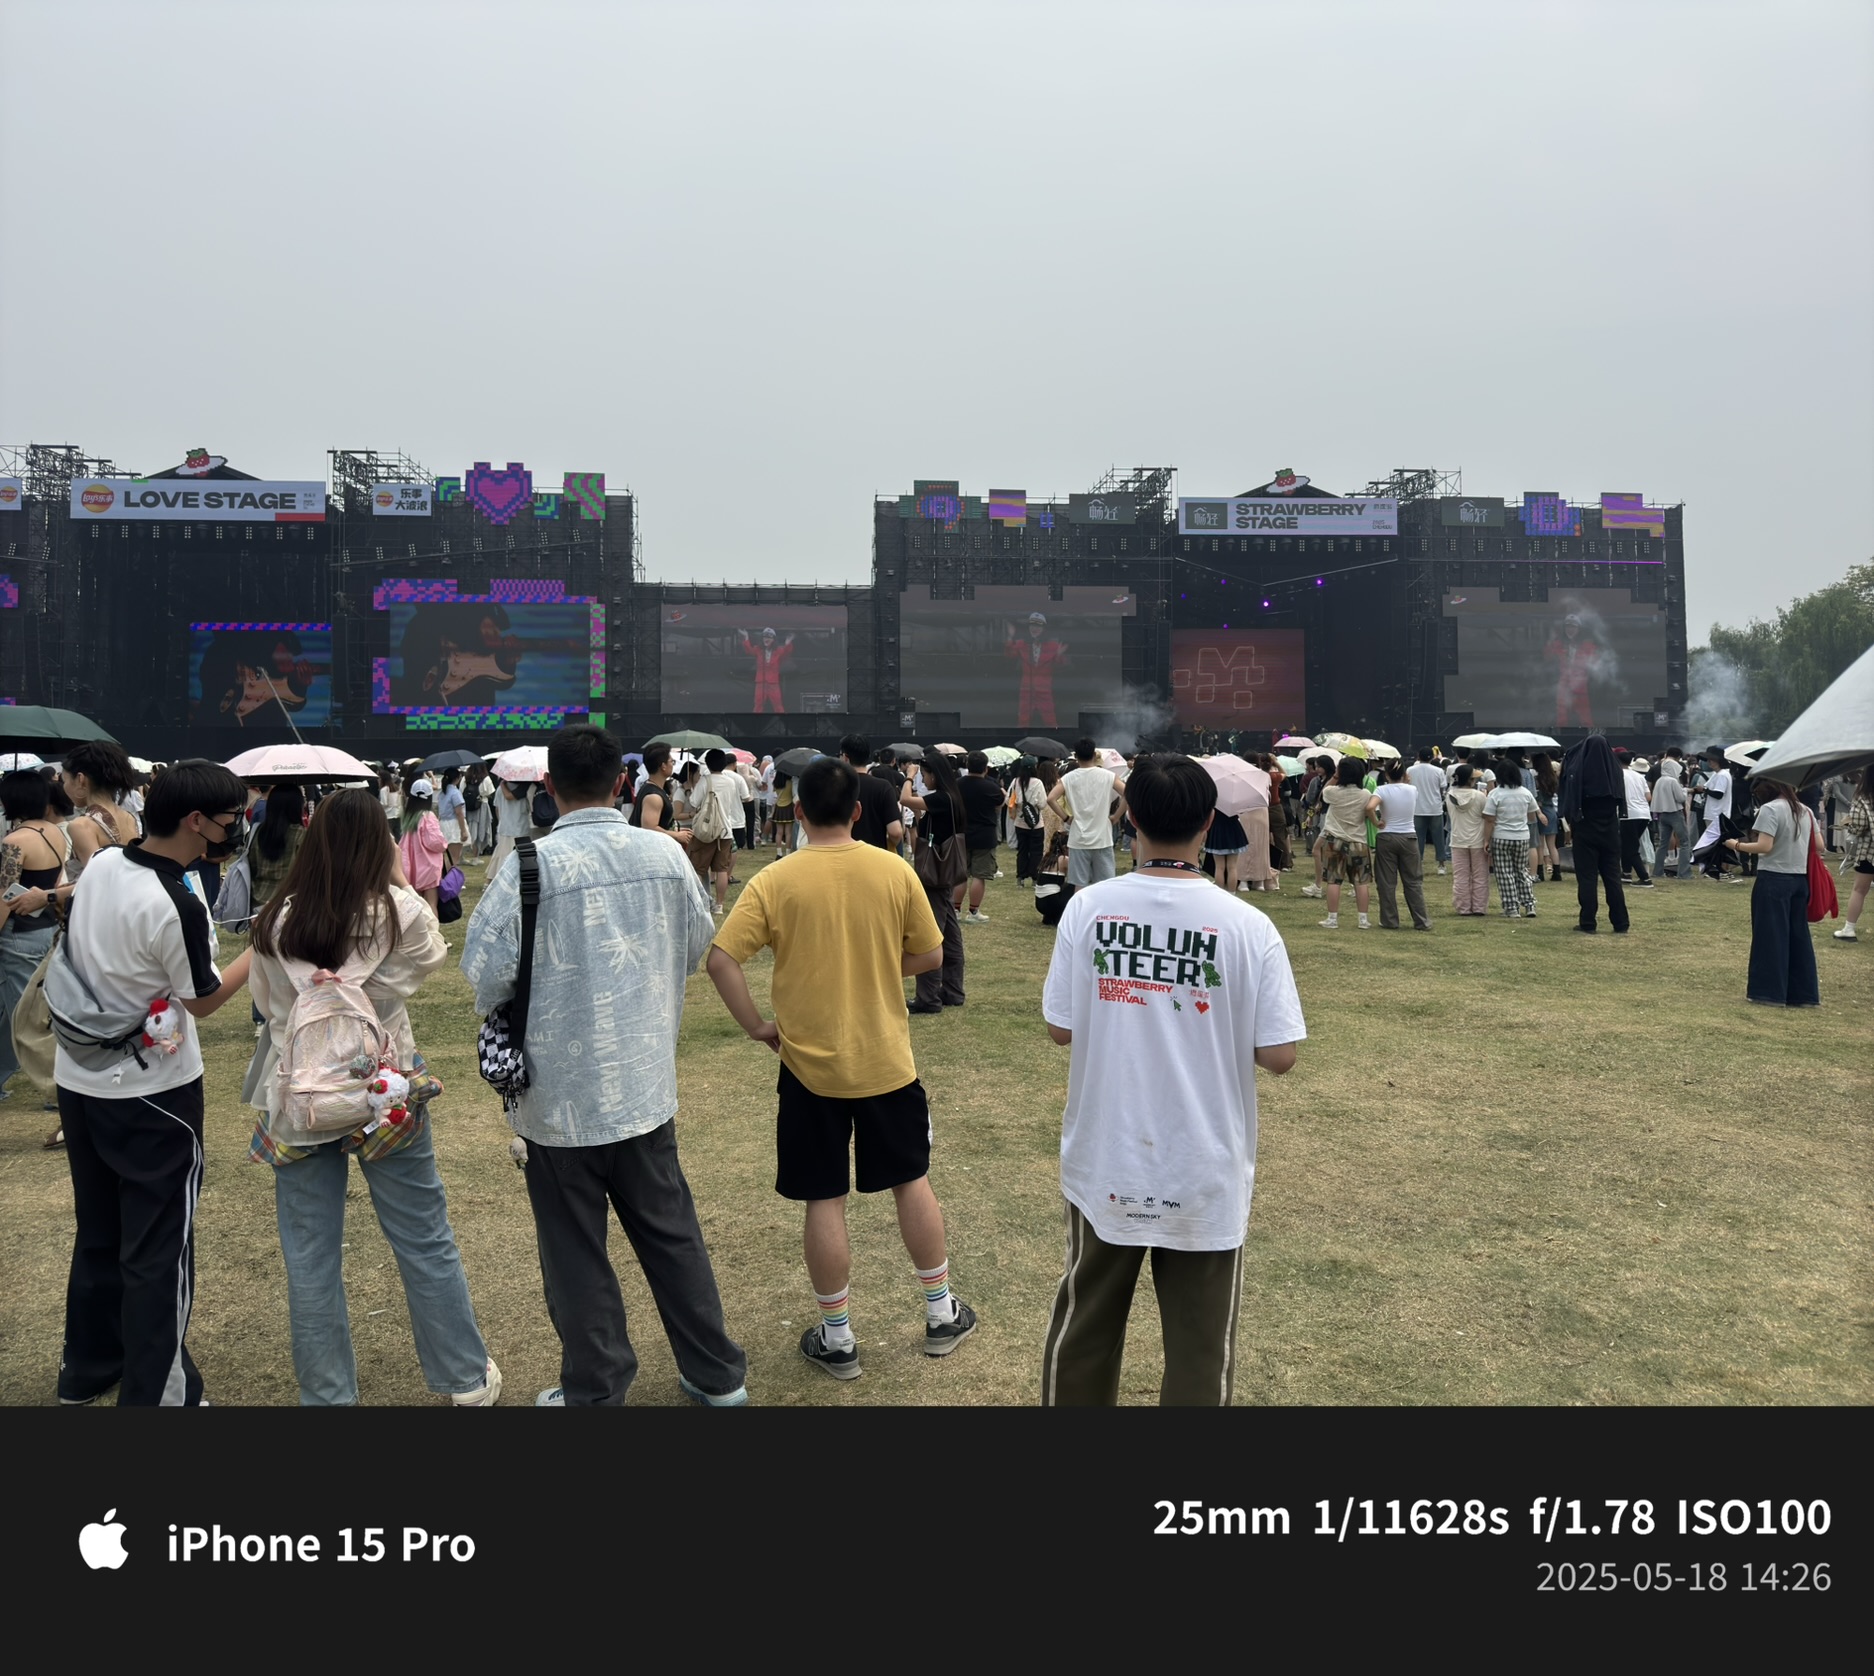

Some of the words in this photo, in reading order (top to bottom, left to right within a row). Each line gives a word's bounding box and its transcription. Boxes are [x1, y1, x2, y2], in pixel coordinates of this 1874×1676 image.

[124, 491, 199, 508] LOVE
[204, 492, 296, 510] STAGE
[1236, 503, 1367, 516] STRAWBERRY
[1236, 516, 1298, 530] STAGE
[1096, 922, 1217, 961] VOLUN
[1109, 950, 1201, 988] TEER
[1098, 978, 1173, 994] STRAWBERRY
[1098, 985, 1130, 995] MUSIC
[1099, 993, 1147, 1006] FESTIVAL
[593, 991, 618, 1058] Wave
